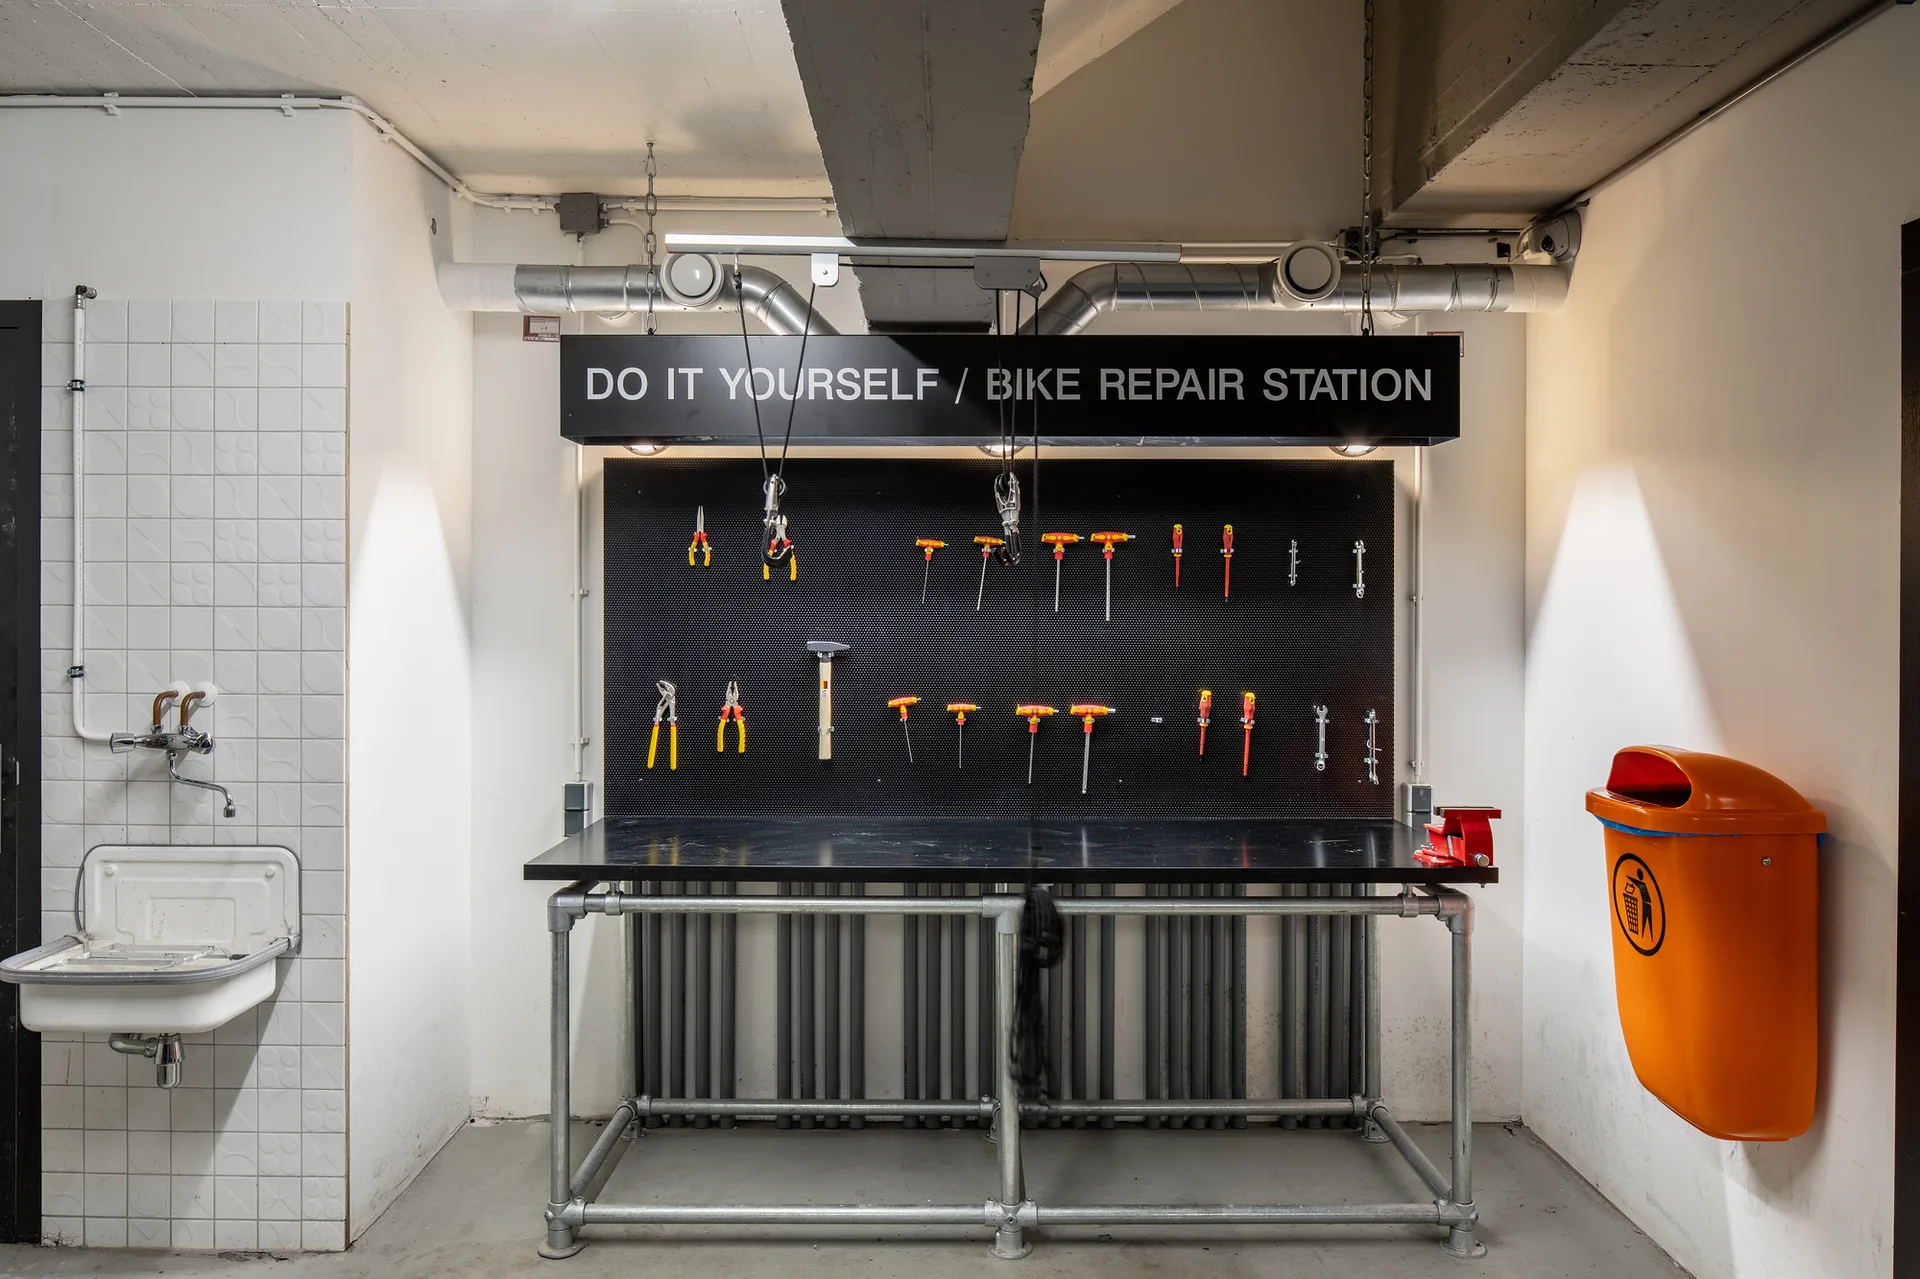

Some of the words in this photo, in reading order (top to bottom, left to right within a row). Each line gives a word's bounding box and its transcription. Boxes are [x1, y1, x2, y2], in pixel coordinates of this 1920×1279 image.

[587, 367, 648, 400] DO
[667, 367, 704, 400] IT
[719, 366, 939, 401] YOURSELF
[955, 368, 968, 403] /
[987, 368, 1081, 400] BIKE
[1101, 368, 1245, 400] REPAIR
[1263, 368, 1432, 401] STATION
